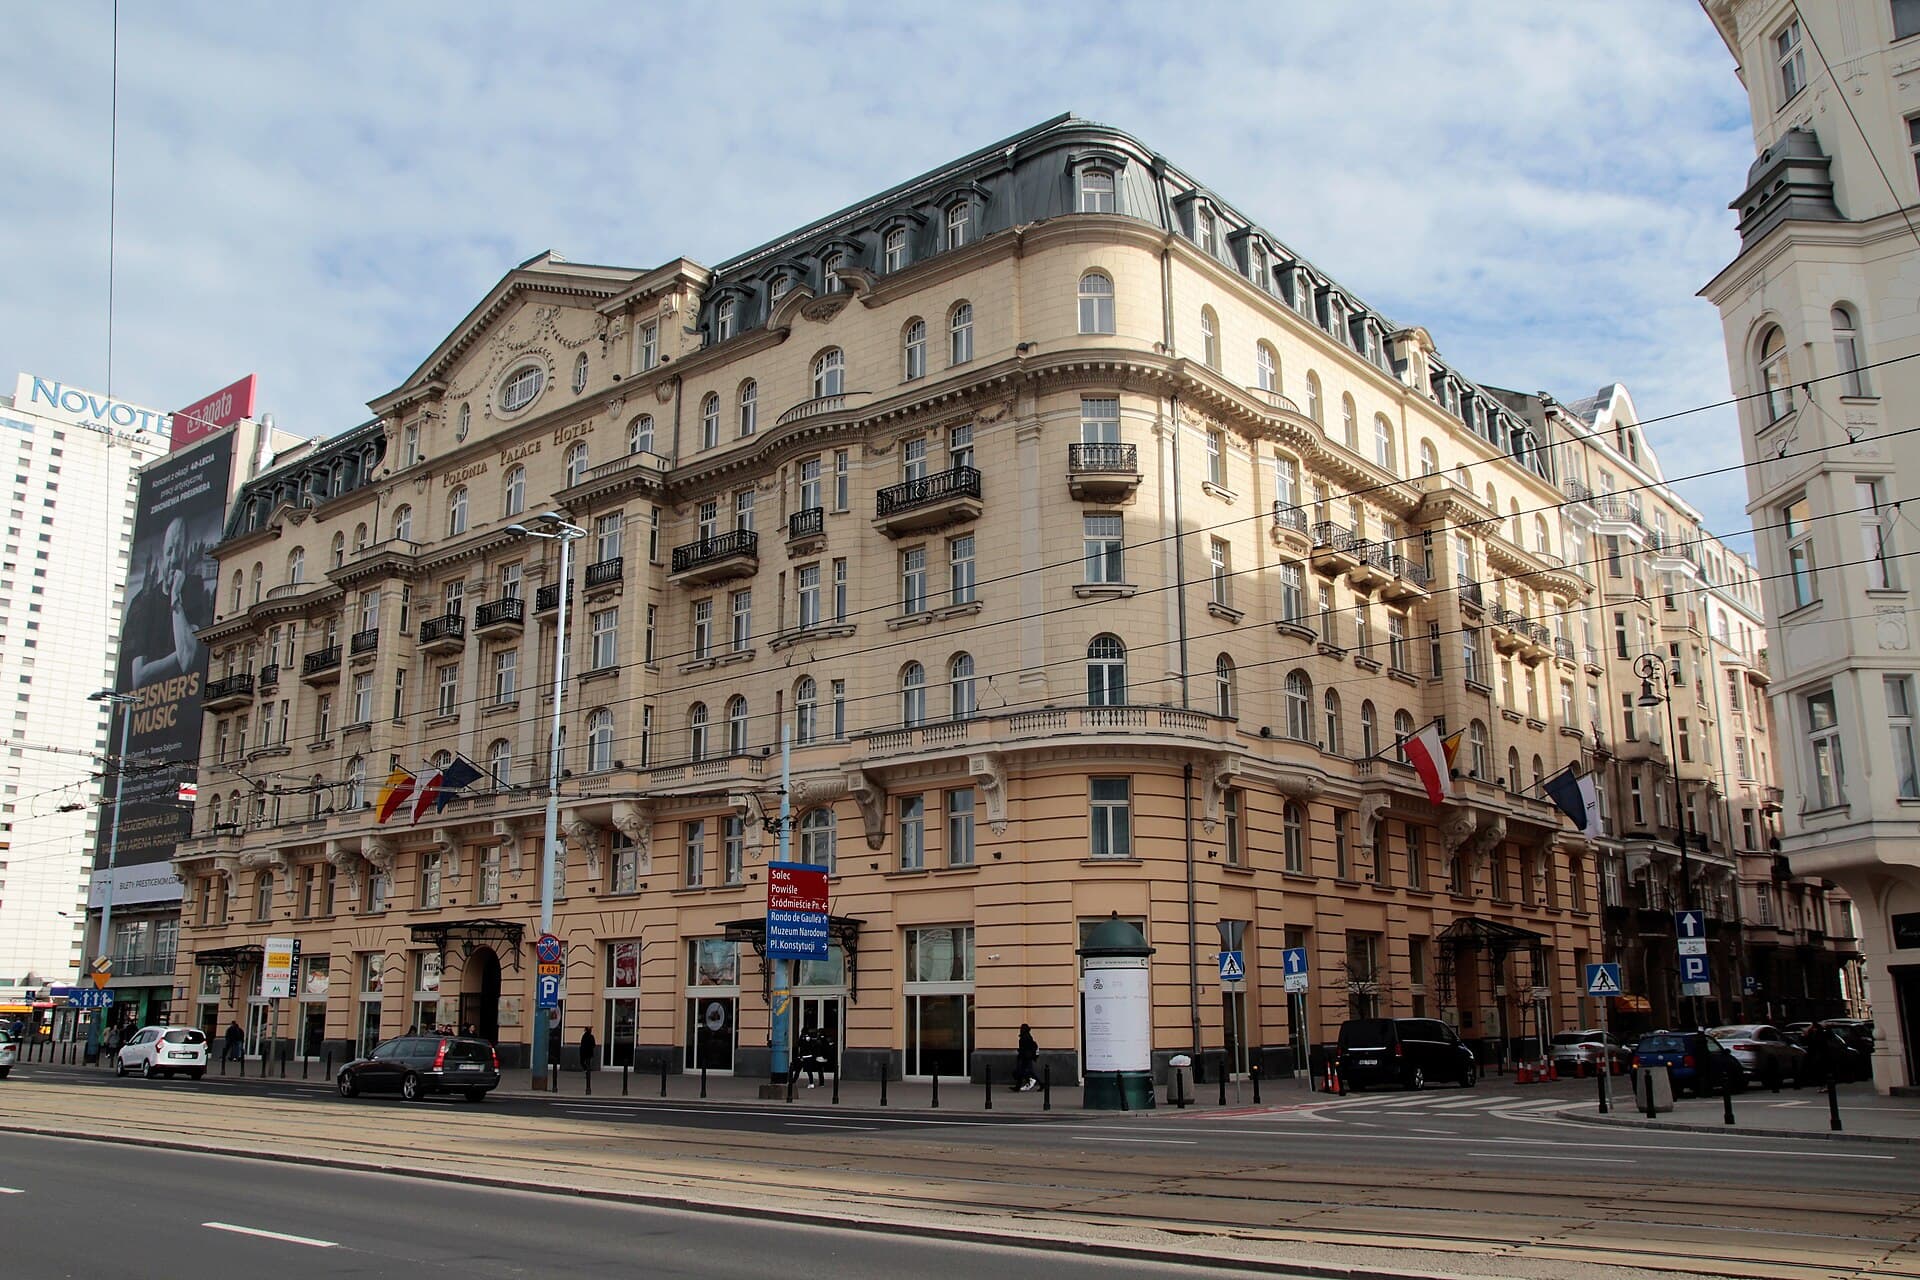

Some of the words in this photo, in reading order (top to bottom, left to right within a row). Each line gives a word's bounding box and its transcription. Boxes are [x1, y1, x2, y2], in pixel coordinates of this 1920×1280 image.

[202, 392, 232, 431] agata
[443, 461, 488, 488] POLONIA
[500, 440, 542, 466] PALACE
[553, 420, 595, 446] HOTEL
[132, 703, 178, 736] MUSIC
[772, 870, 790, 880] Solec
[771, 883, 798, 895] Powiśle
[771, 896, 811, 909] Śródmieście
[771, 911, 791, 921] Rondo
[792, 912, 800, 922] de
[770, 926, 798, 936] Muzeum
[800, 927, 827, 938] Narodowe
[1686, 958, 1703, 980] P
[543, 981, 555, 999] P
